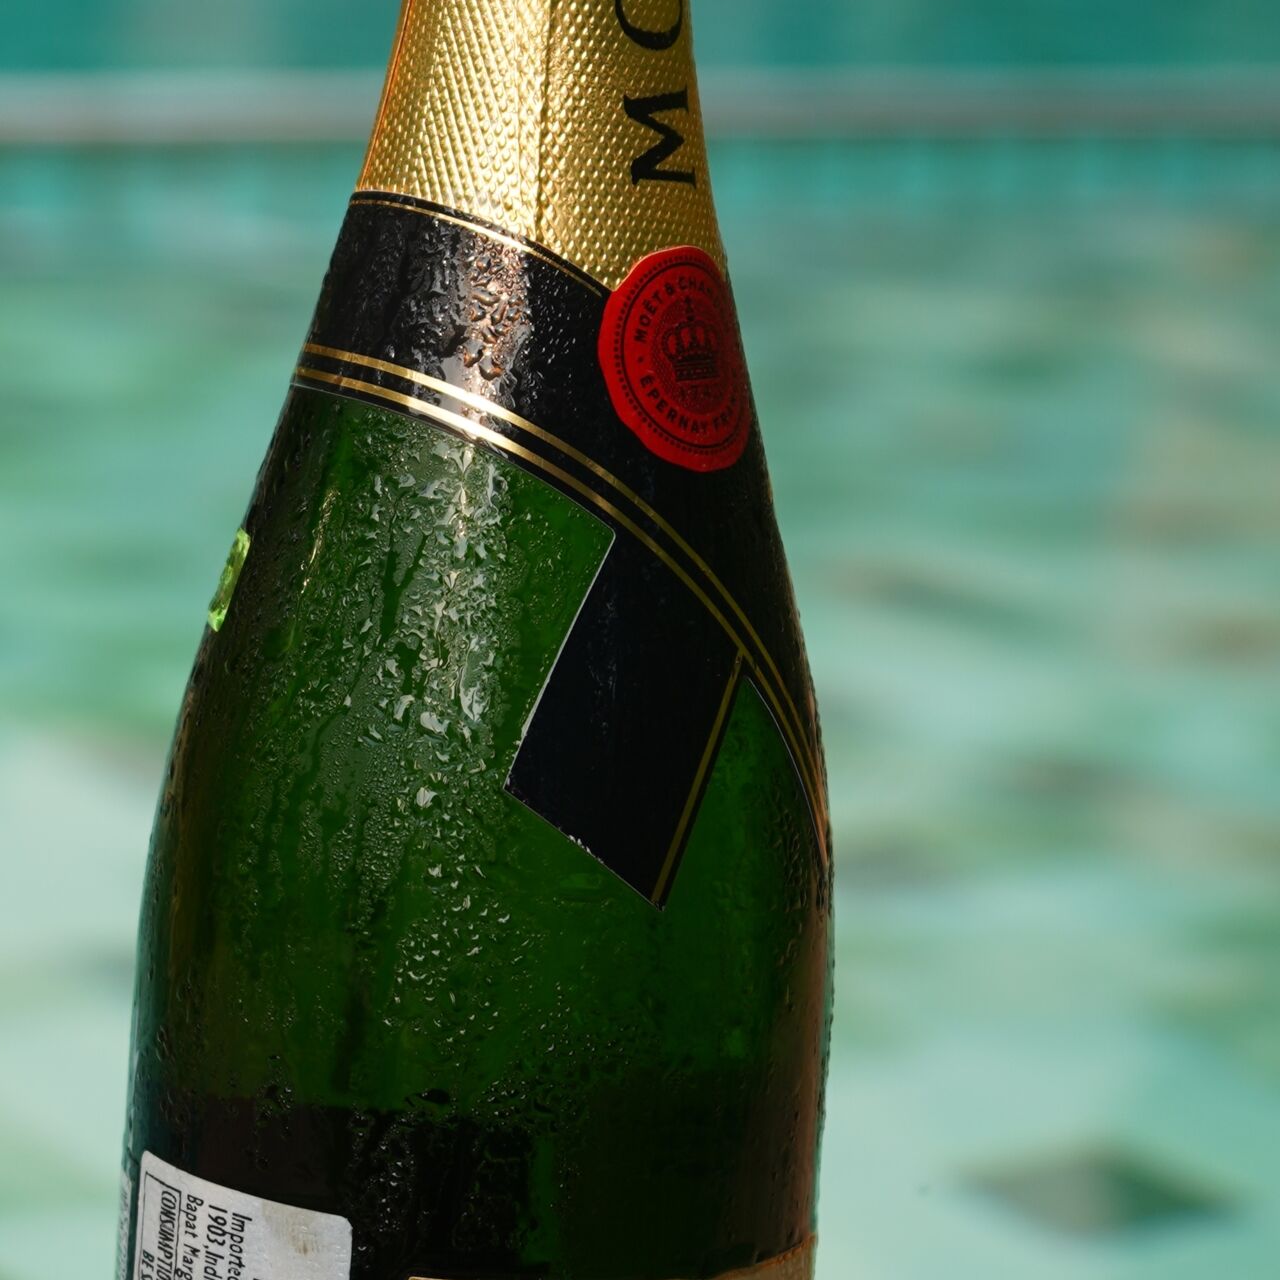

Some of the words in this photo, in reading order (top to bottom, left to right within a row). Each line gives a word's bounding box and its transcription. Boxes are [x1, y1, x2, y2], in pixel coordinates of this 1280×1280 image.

[634, 291, 663, 344] MOËT
[181, 1195, 202, 1238] Bapat
[141, 1250, 154, 1269] BE
